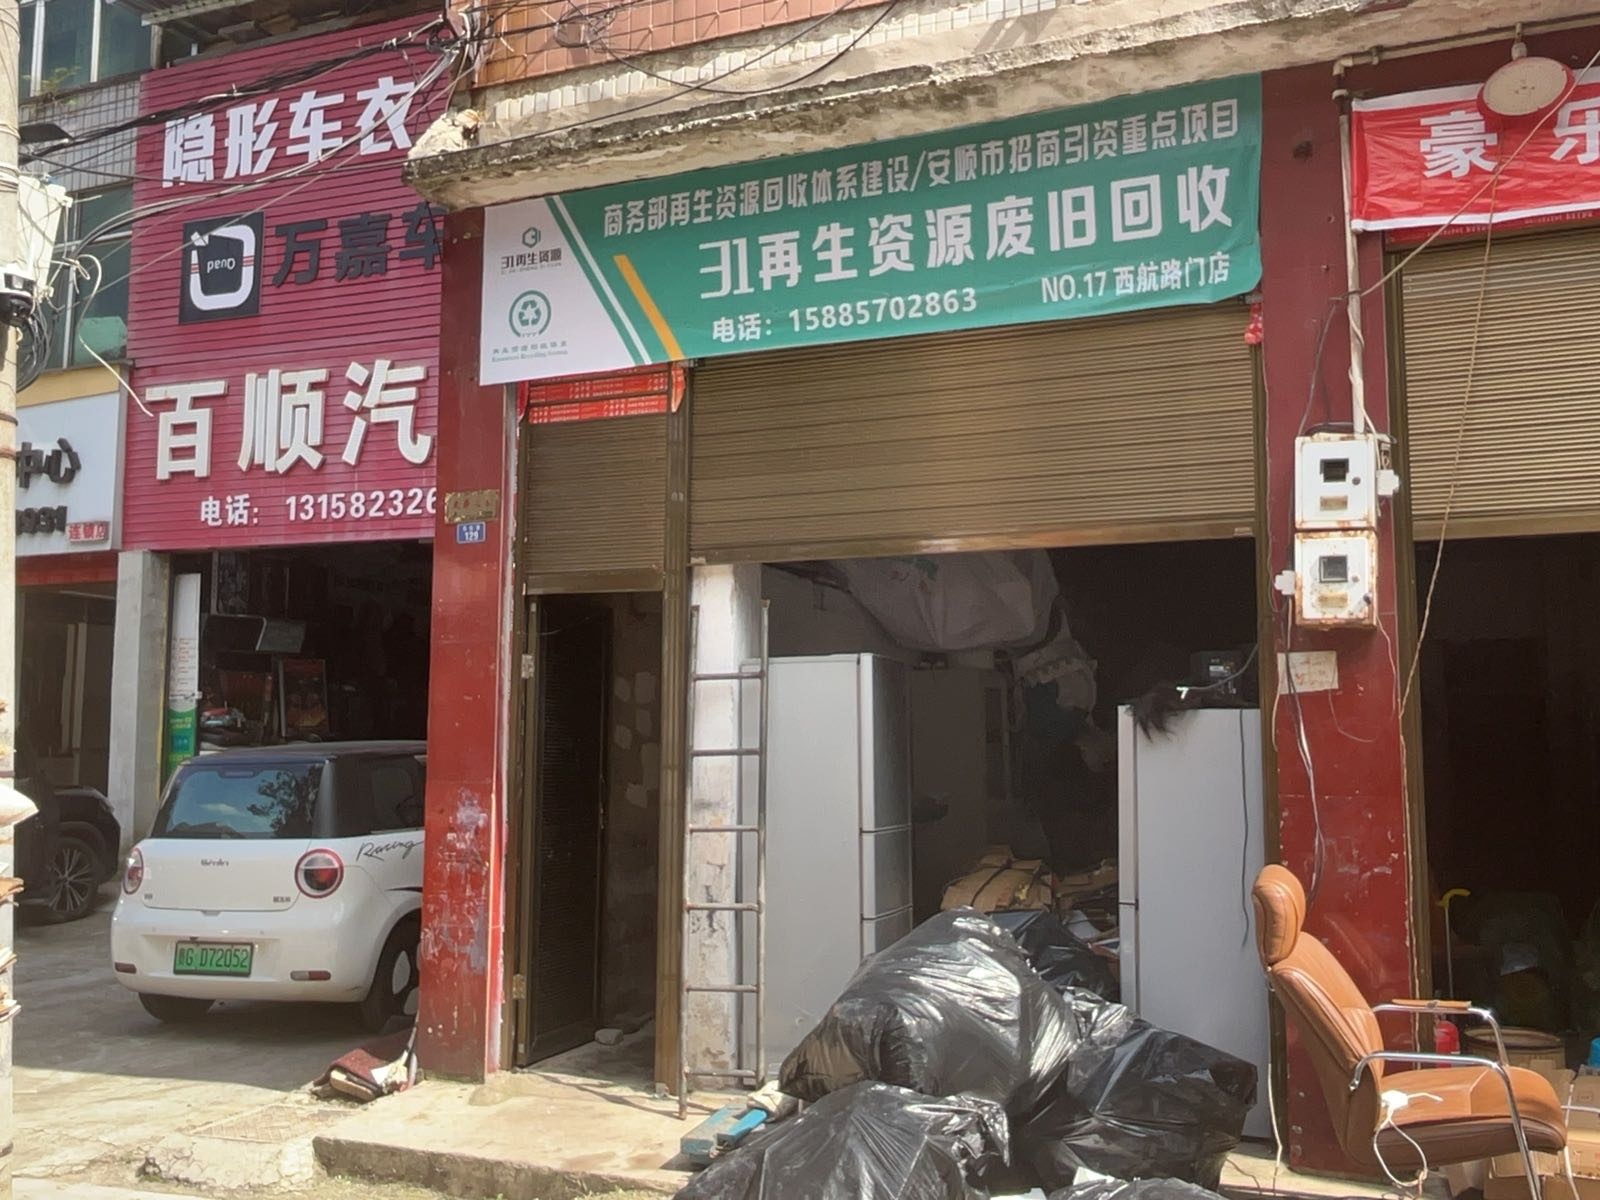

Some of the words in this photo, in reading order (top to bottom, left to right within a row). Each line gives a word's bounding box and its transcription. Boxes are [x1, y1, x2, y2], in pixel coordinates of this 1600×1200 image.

[162, 76, 416, 189] 隐形车衣
[603, 98, 1239, 239] 商务部再生资源回收体系建设/安顺市招商引资重点项目
[272, 202, 445, 288] 万嘉车
[1113, 251, 1231, 295] 西航路门店
[789, 287, 978, 331] 15885702863
[145, 359, 434, 481] 百顺汽
[285, 487, 437, 522] 131582326
